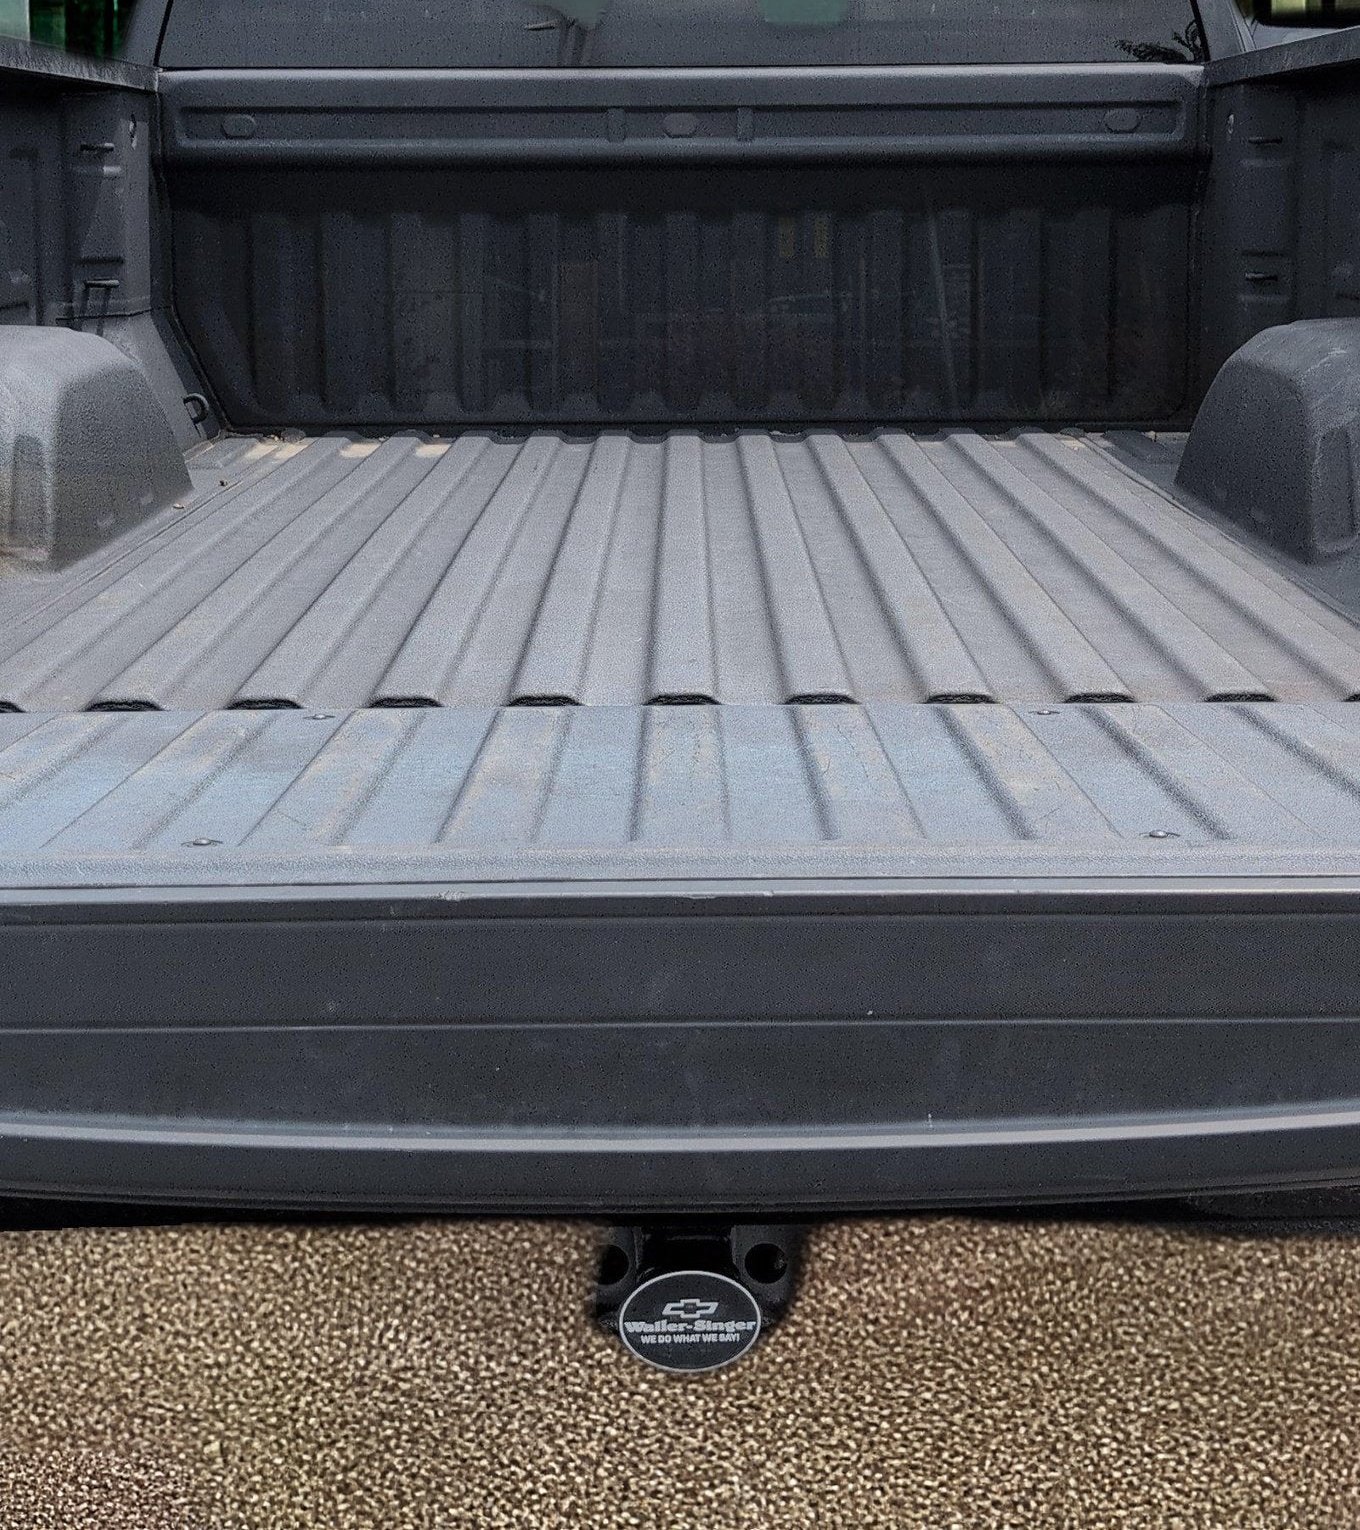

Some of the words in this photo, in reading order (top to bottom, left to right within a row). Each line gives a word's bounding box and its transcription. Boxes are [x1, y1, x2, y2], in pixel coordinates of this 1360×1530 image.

[623, 1319, 757, 1333] Waller-Singer
[640, 1334, 657, 1344] WE
[658, 1334, 672, 1343] DO
[673, 1333, 701, 1343] WHAT
[702, 1333, 718, 1343] WE
